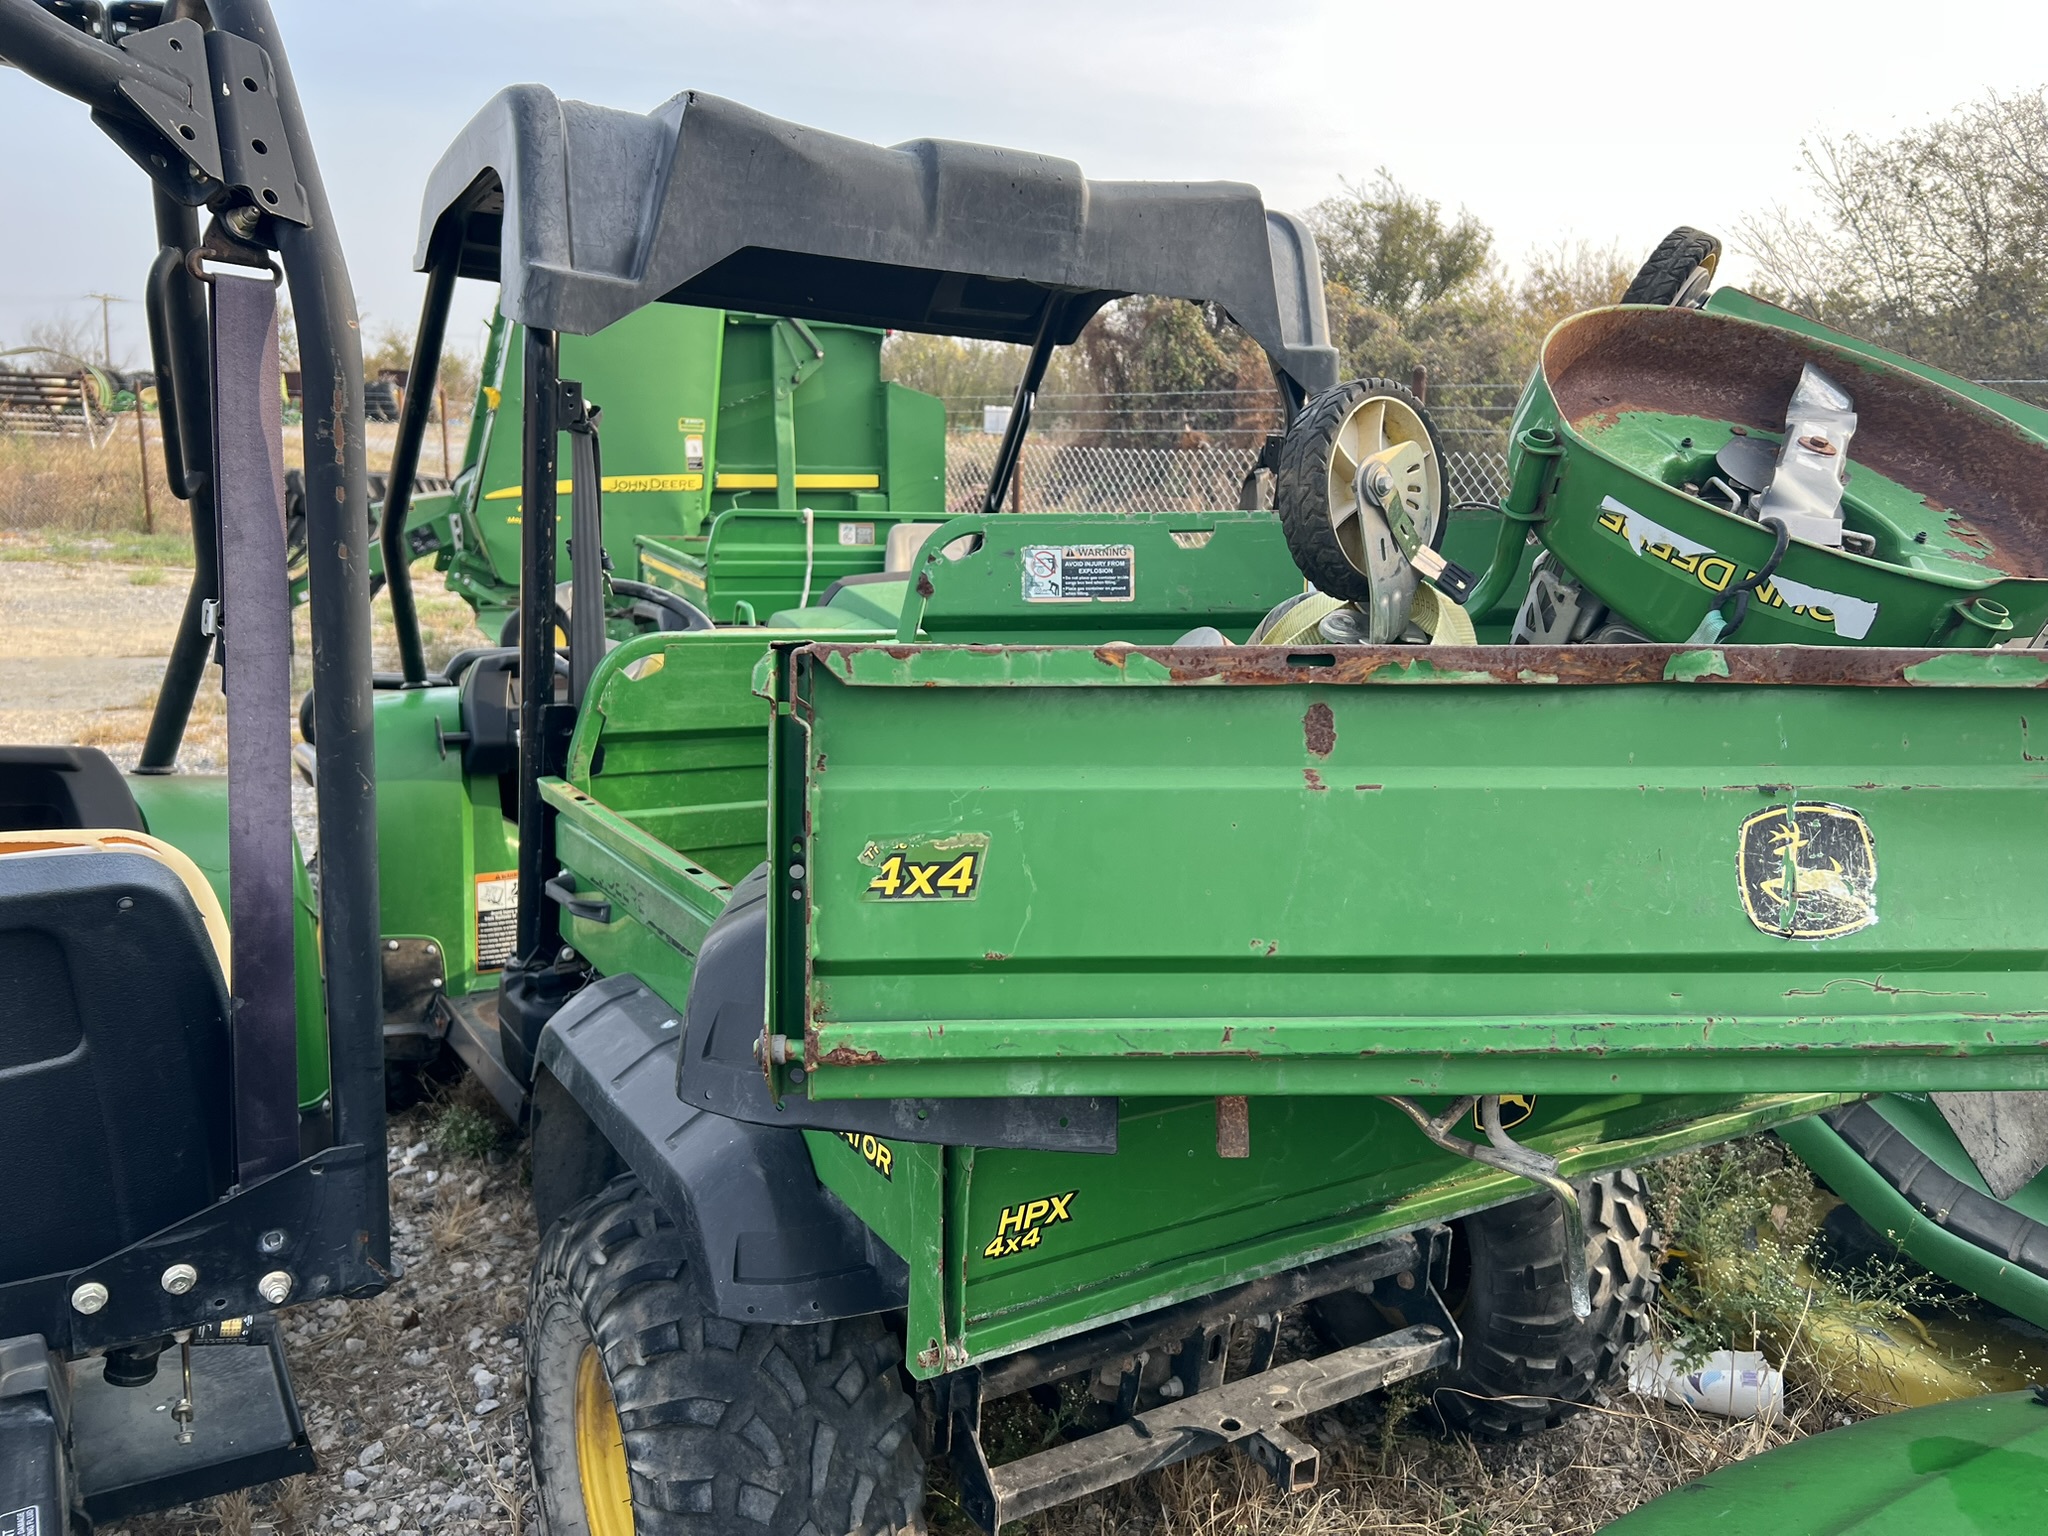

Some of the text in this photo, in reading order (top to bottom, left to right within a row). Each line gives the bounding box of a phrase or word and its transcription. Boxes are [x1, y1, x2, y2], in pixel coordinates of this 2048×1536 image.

[610, 478, 696, 490] JOHN DEERE
[1078, 548, 1127, 557] WARNING
[869, 854, 976, 897] 4x4
[997, 1192, 1075, 1236] HPX
[983, 1227, 1042, 1258] 4x4
